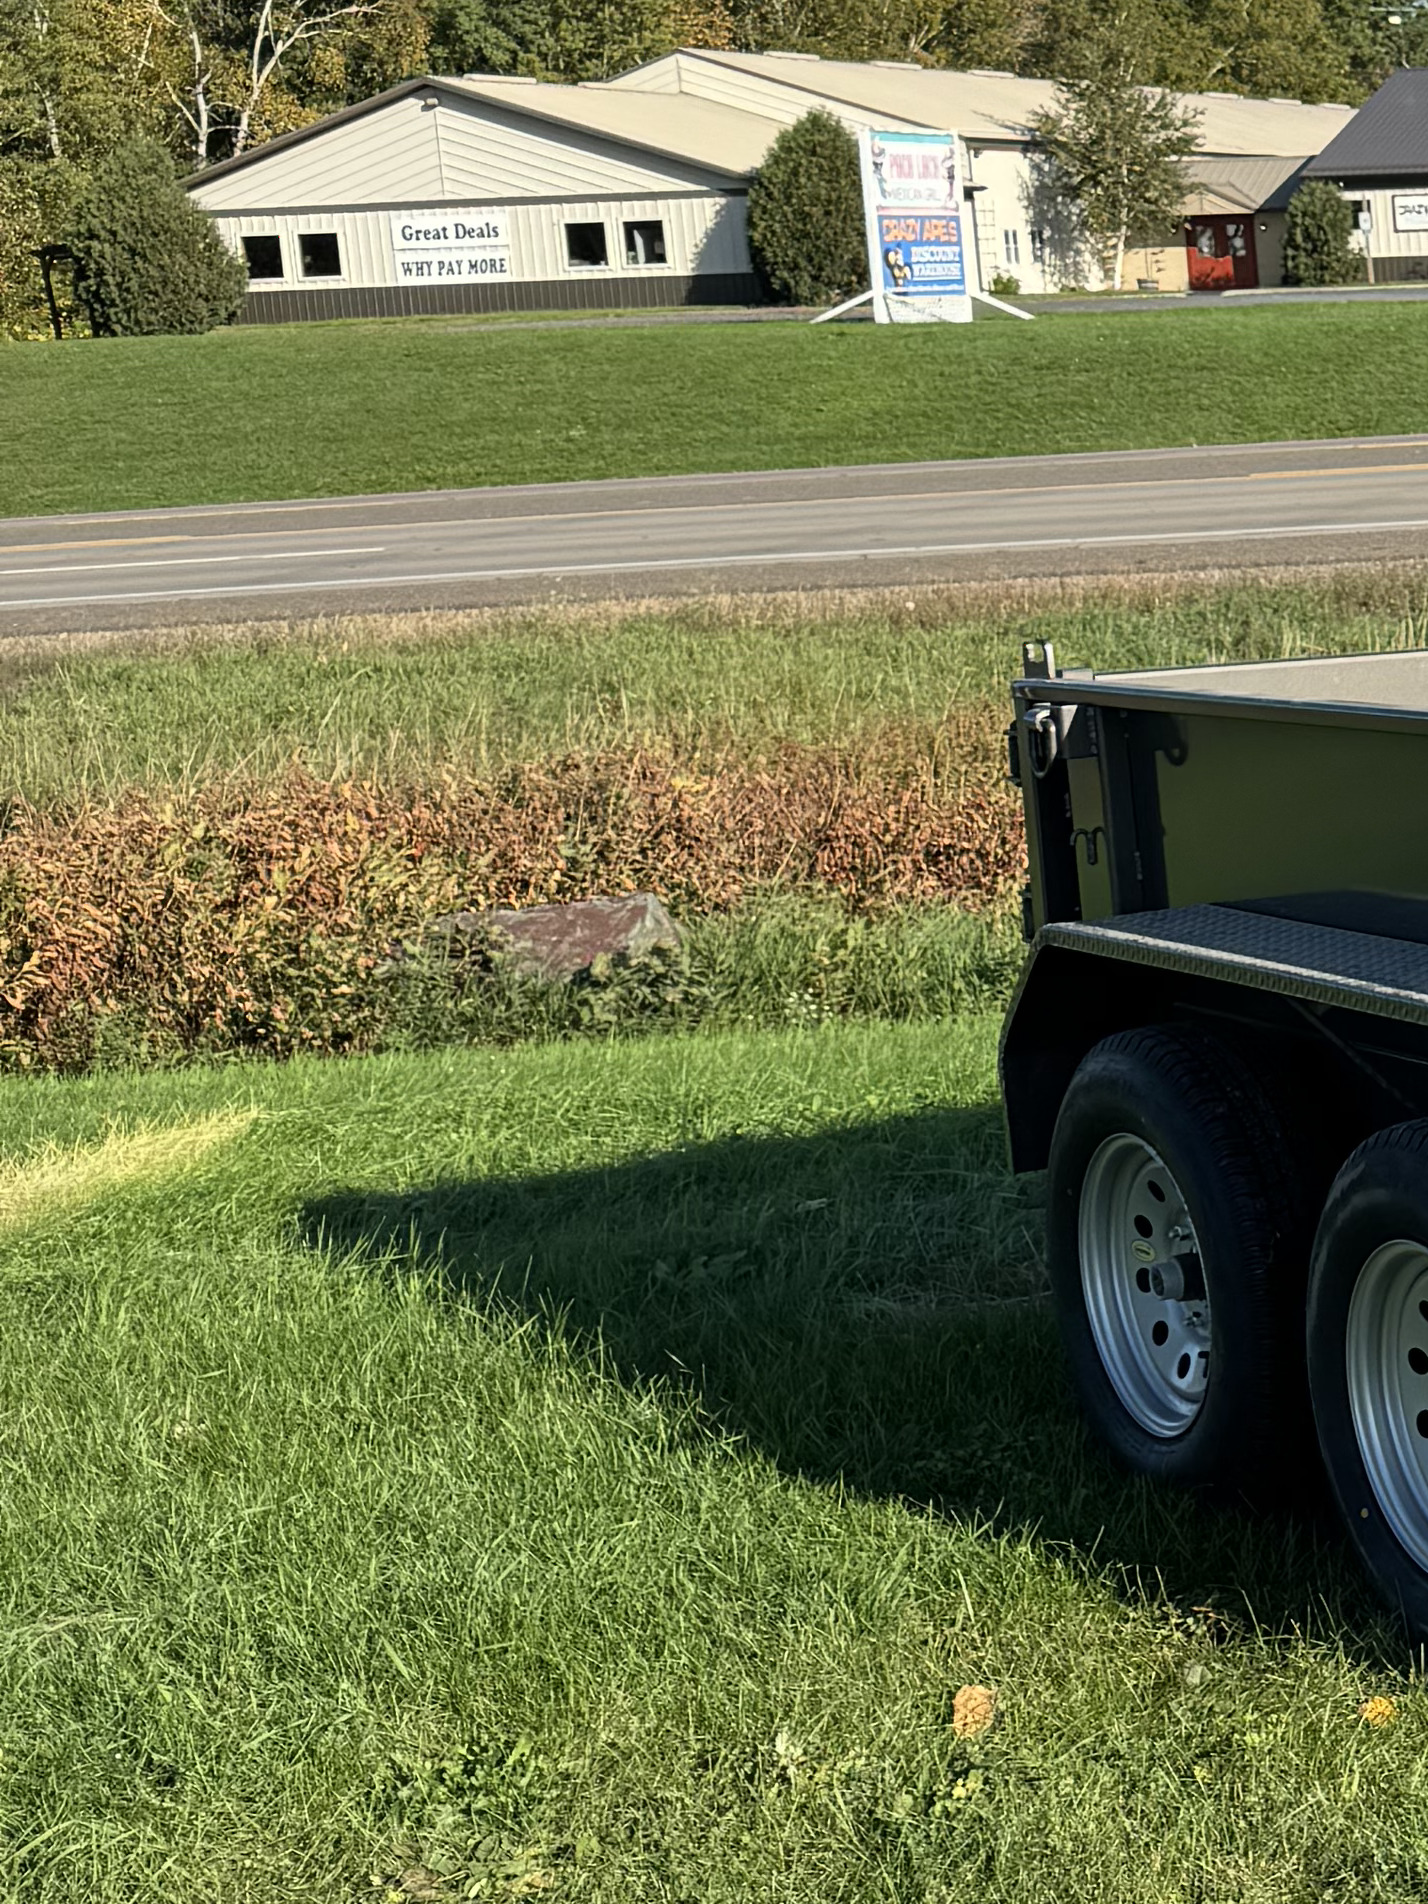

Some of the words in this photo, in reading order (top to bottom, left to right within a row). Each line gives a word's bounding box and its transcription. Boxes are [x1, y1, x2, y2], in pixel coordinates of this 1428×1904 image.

[401, 225, 449, 241] Great
[454, 222, 499, 239] Deals
[401, 261, 433, 276] WHY
[438, 260, 463, 276] PAY
[468, 258, 507, 274] MORE
